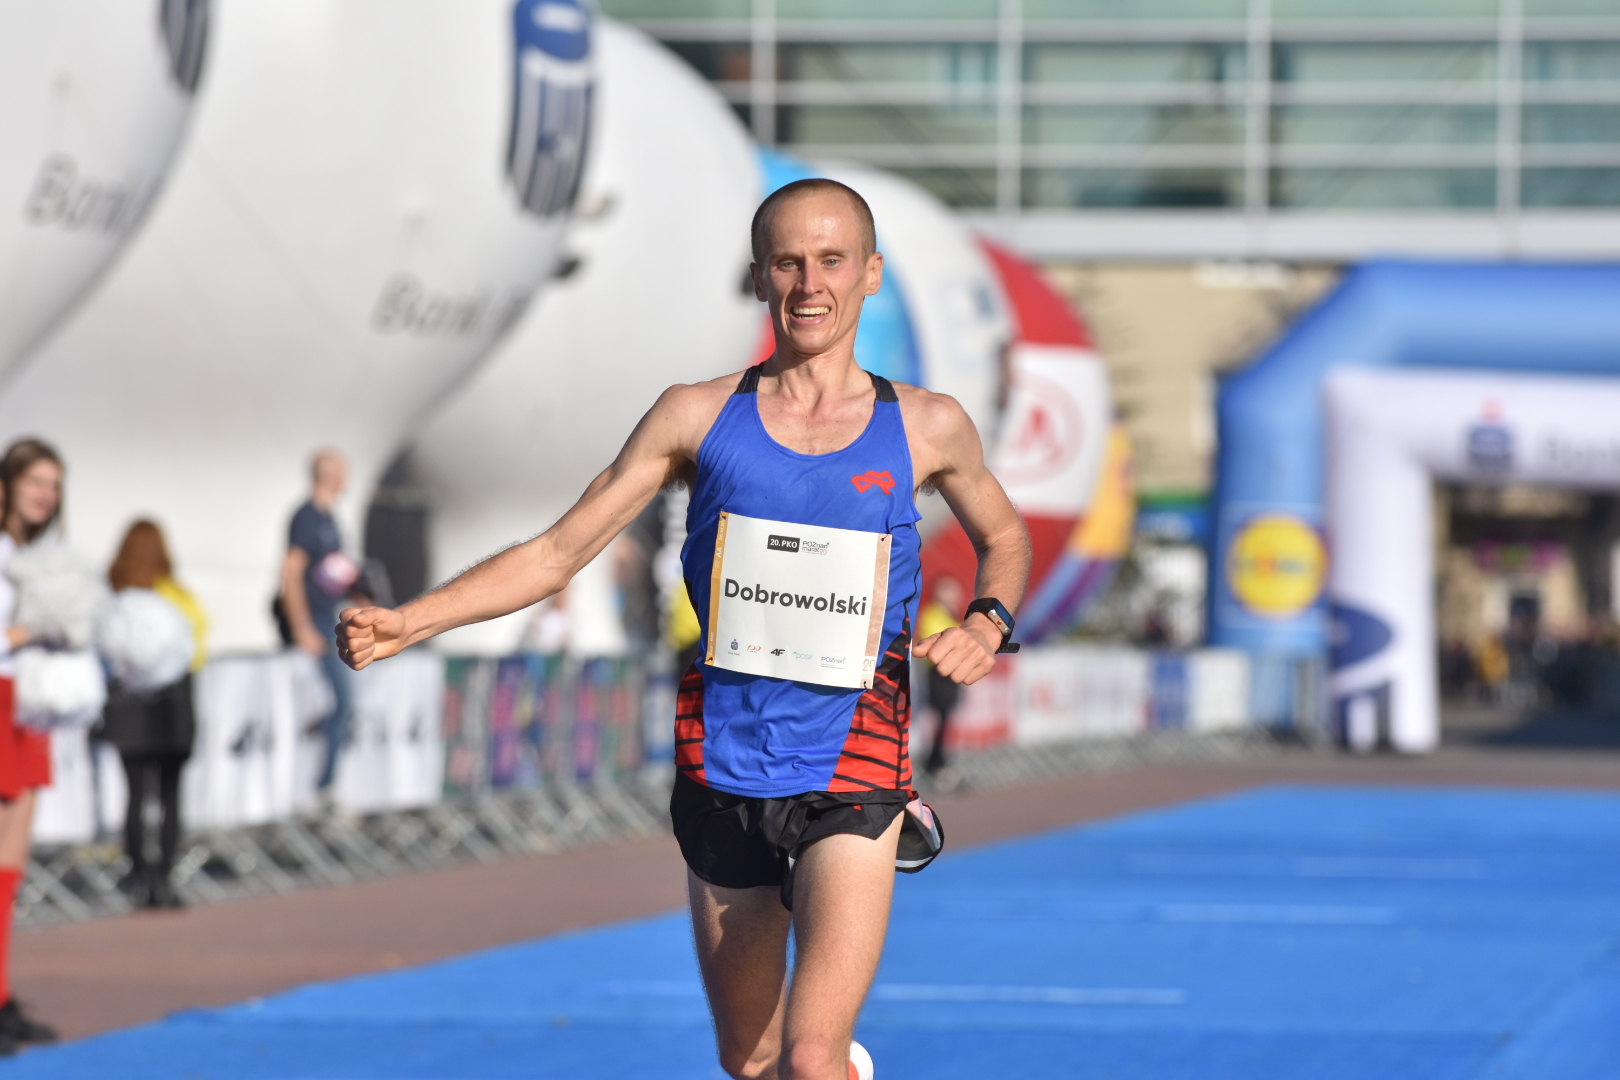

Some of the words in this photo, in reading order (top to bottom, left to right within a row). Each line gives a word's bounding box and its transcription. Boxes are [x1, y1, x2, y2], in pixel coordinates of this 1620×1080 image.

[770, 538, 780, 547] 20.
[781, 540, 798, 549] PKO
[724, 578, 867, 616] Dobrowolski
